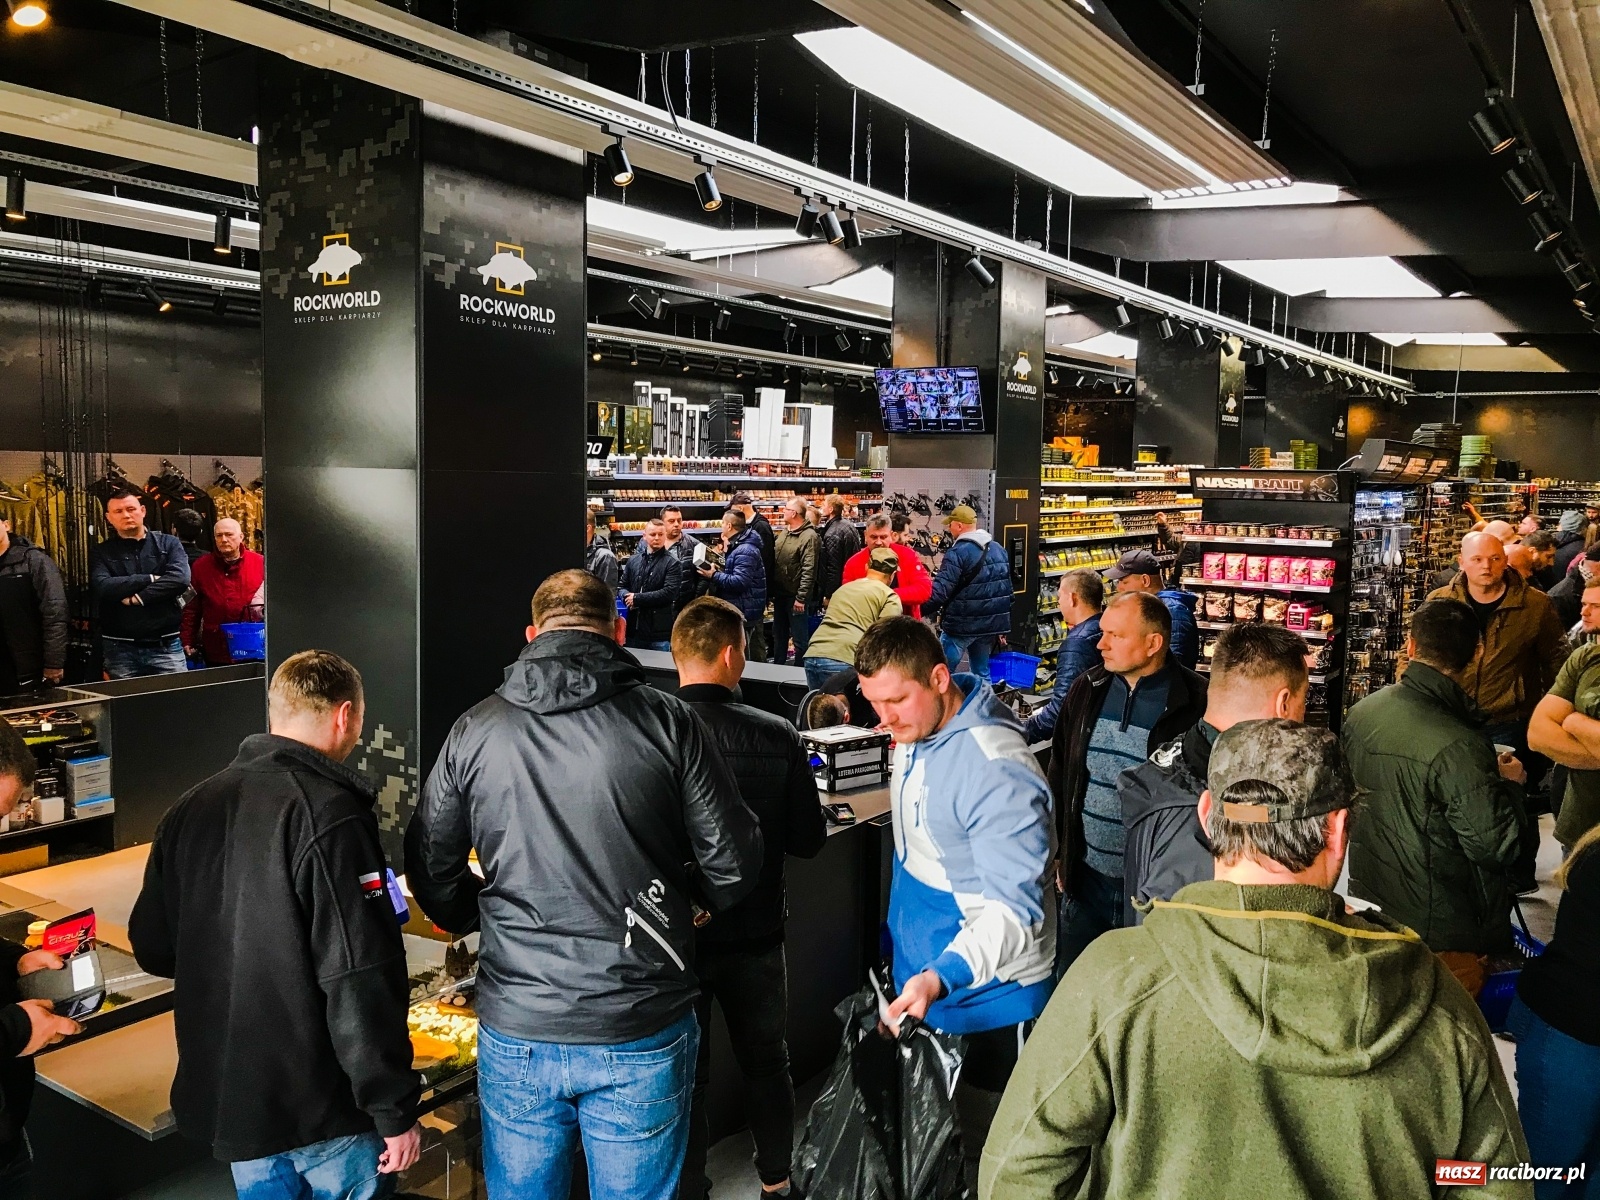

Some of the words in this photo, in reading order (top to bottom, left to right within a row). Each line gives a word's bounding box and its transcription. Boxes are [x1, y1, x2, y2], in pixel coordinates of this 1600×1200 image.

[293, 290, 381, 312] ROCKWORLD
[460, 293, 556, 324] ROCKWORLD
[294, 316, 316, 324] SKLEP
[338, 312, 381, 321] KARPIARZY
[460, 315, 486, 325] SKLEP
[492, 319, 508, 328] DLA
[512, 323, 556, 336] KARPIARZY
[1006, 381, 1037, 395] ROCKWORLD
[48, 929, 86, 945] CITRUZ
